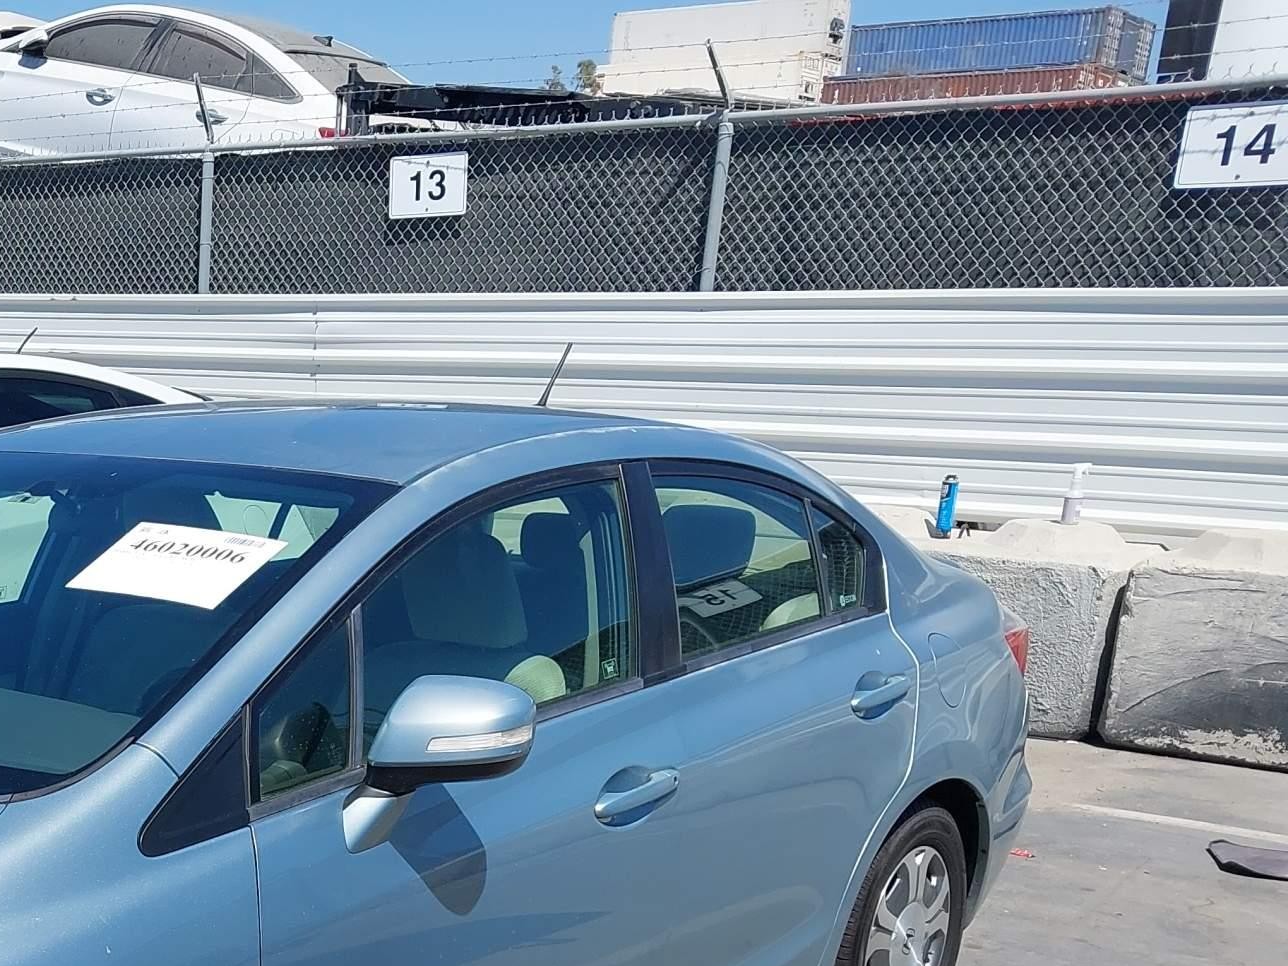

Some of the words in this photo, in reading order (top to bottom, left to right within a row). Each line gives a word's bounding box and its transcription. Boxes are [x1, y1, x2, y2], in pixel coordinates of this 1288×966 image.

[1216, 123, 1277, 167] 14
[410, 169, 446, 201] 13
[129, 538, 249, 564] 46020006
